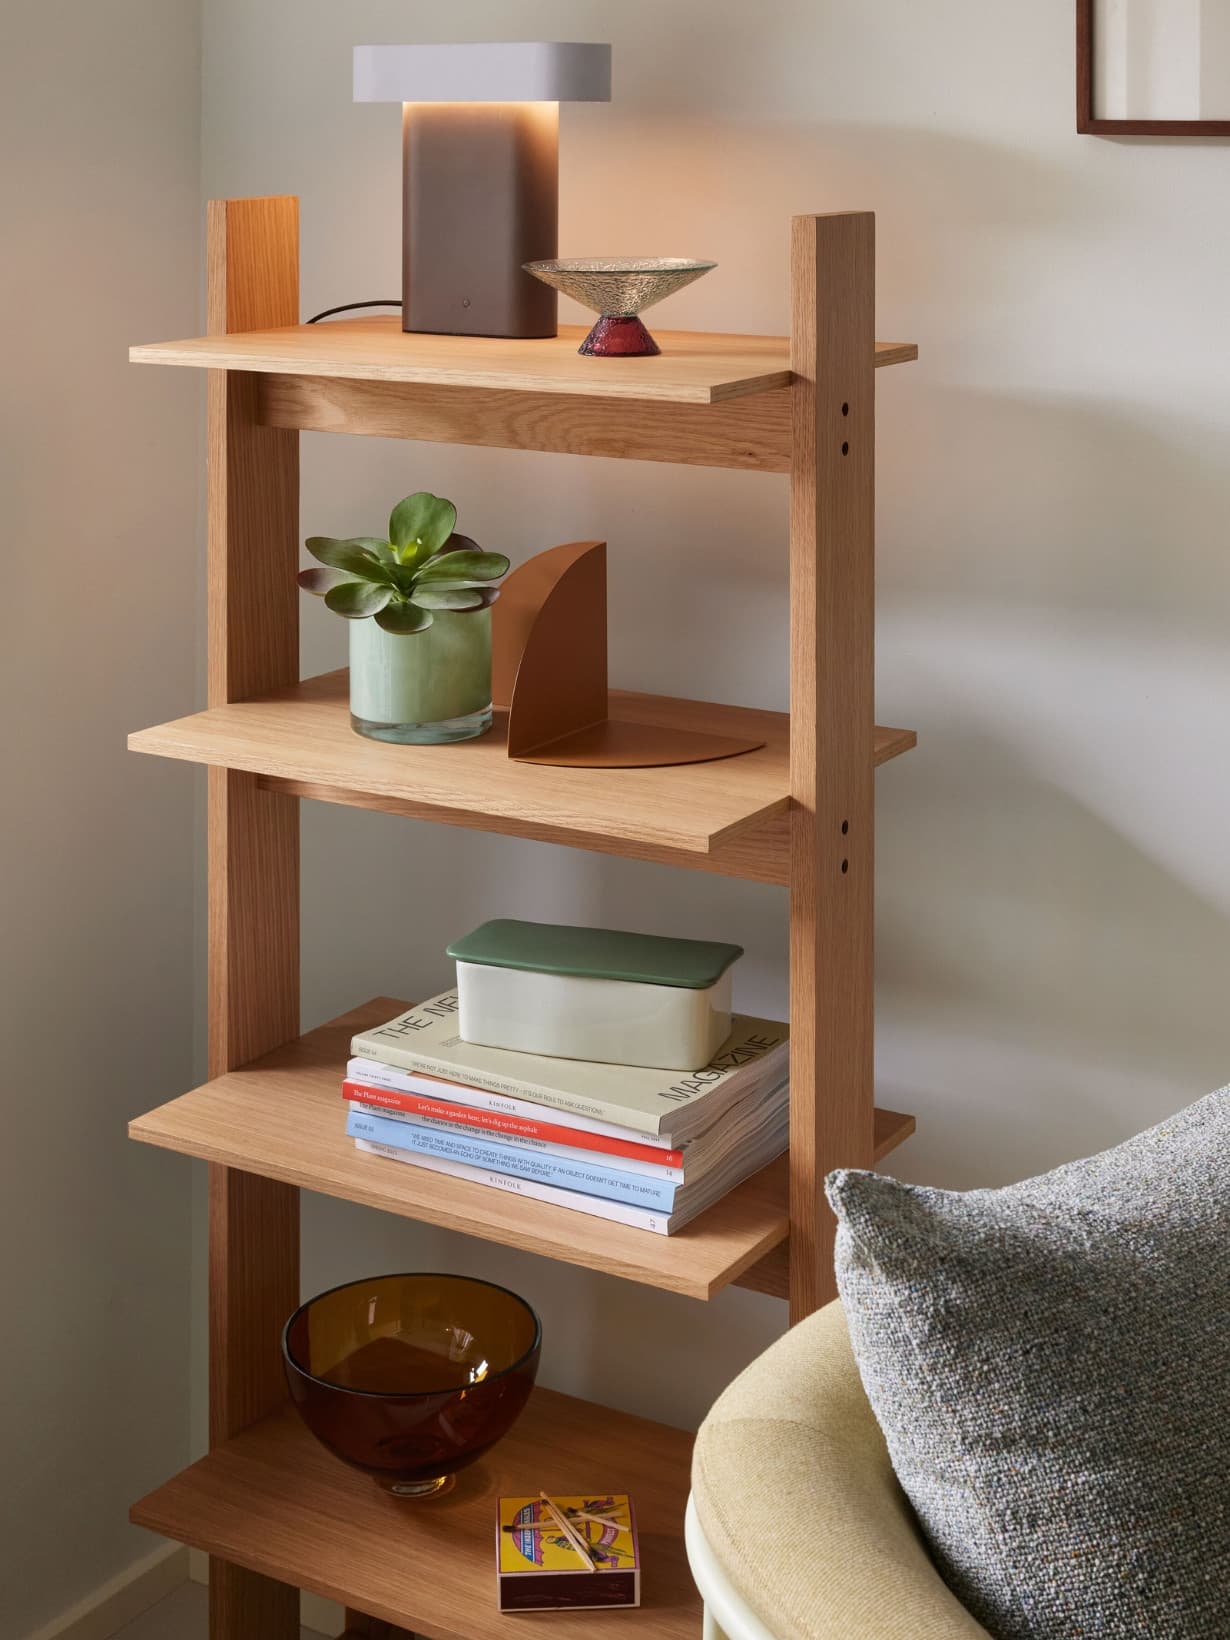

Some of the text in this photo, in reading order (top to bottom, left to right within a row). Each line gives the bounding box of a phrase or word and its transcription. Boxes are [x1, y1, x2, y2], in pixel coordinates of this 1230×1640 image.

[372, 995, 459, 1038] THE NE
[657, 1034, 780, 1102] MAGAZINE
[363, 1092, 376, 1100] Plant
[377, 1096, 400, 1105] magazine
[488, 1100, 516, 1111] KINFOLK
[382, 1108, 405, 1117] magazine
[418, 1103, 430, 1111] Let's
[430, 1106, 444, 1114] make
[448, 1110, 467, 1118] garden
[492, 1118, 500, 1127] dig
[509, 1122, 518, 1130] the
[518, 1125, 538, 1134] asphalt
[495, 1132, 513, 1140] change
[416, 1140, 428, 1148] JUST
[490, 1176, 520, 1189] KINFOLK
[608, 1178, 618, 1187] GET
[620, 1182, 631, 1190] TIME
